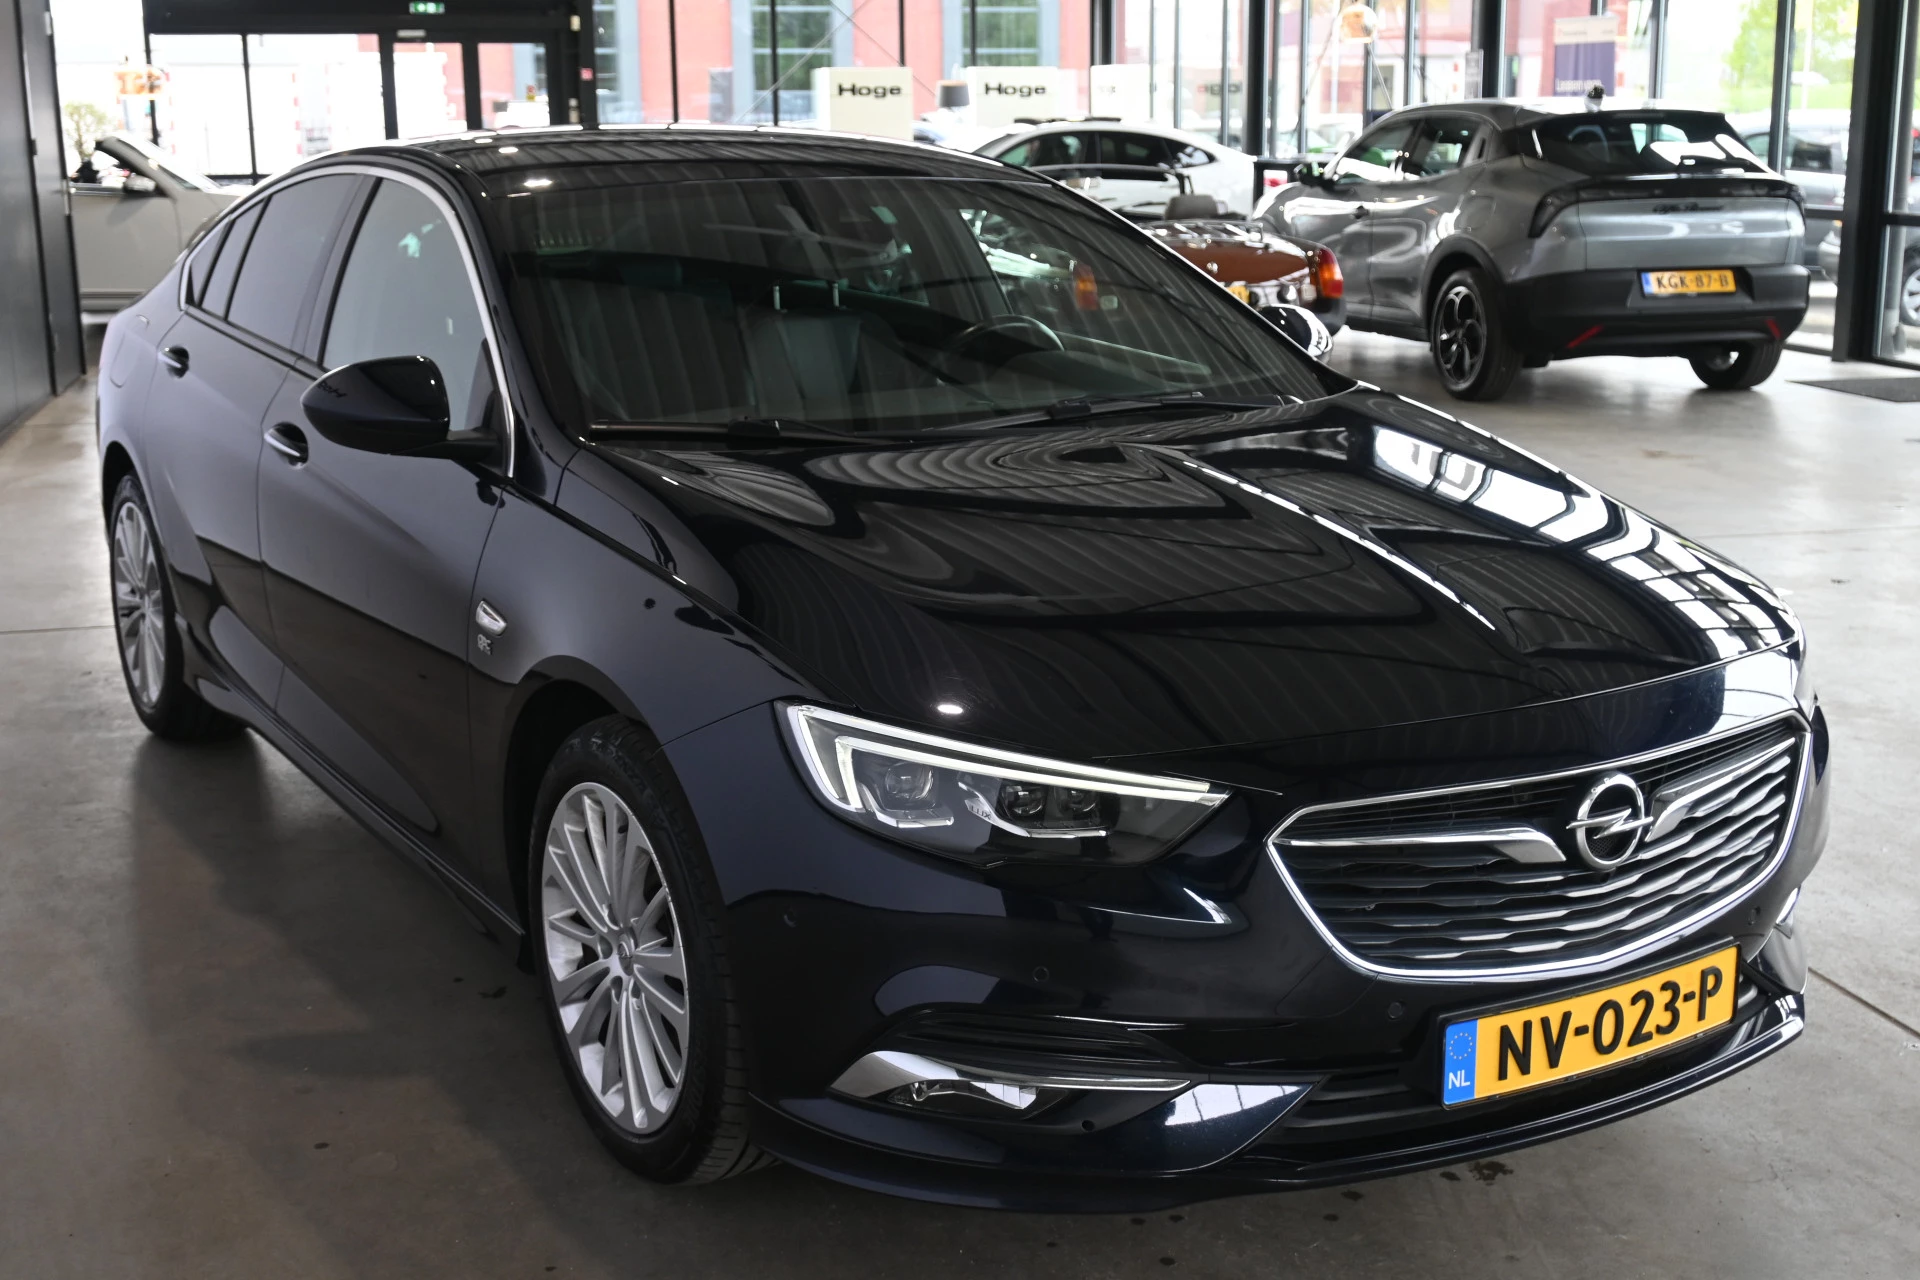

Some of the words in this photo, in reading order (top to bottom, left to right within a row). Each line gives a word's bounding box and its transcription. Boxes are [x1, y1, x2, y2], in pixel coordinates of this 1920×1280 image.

[838, 83, 902, 98] Hoge
[984, 82, 1046, 97] Hoge
[1497, 966, 1723, 1082] NV-023-P
[1448, 1071, 1471, 1090] NL
